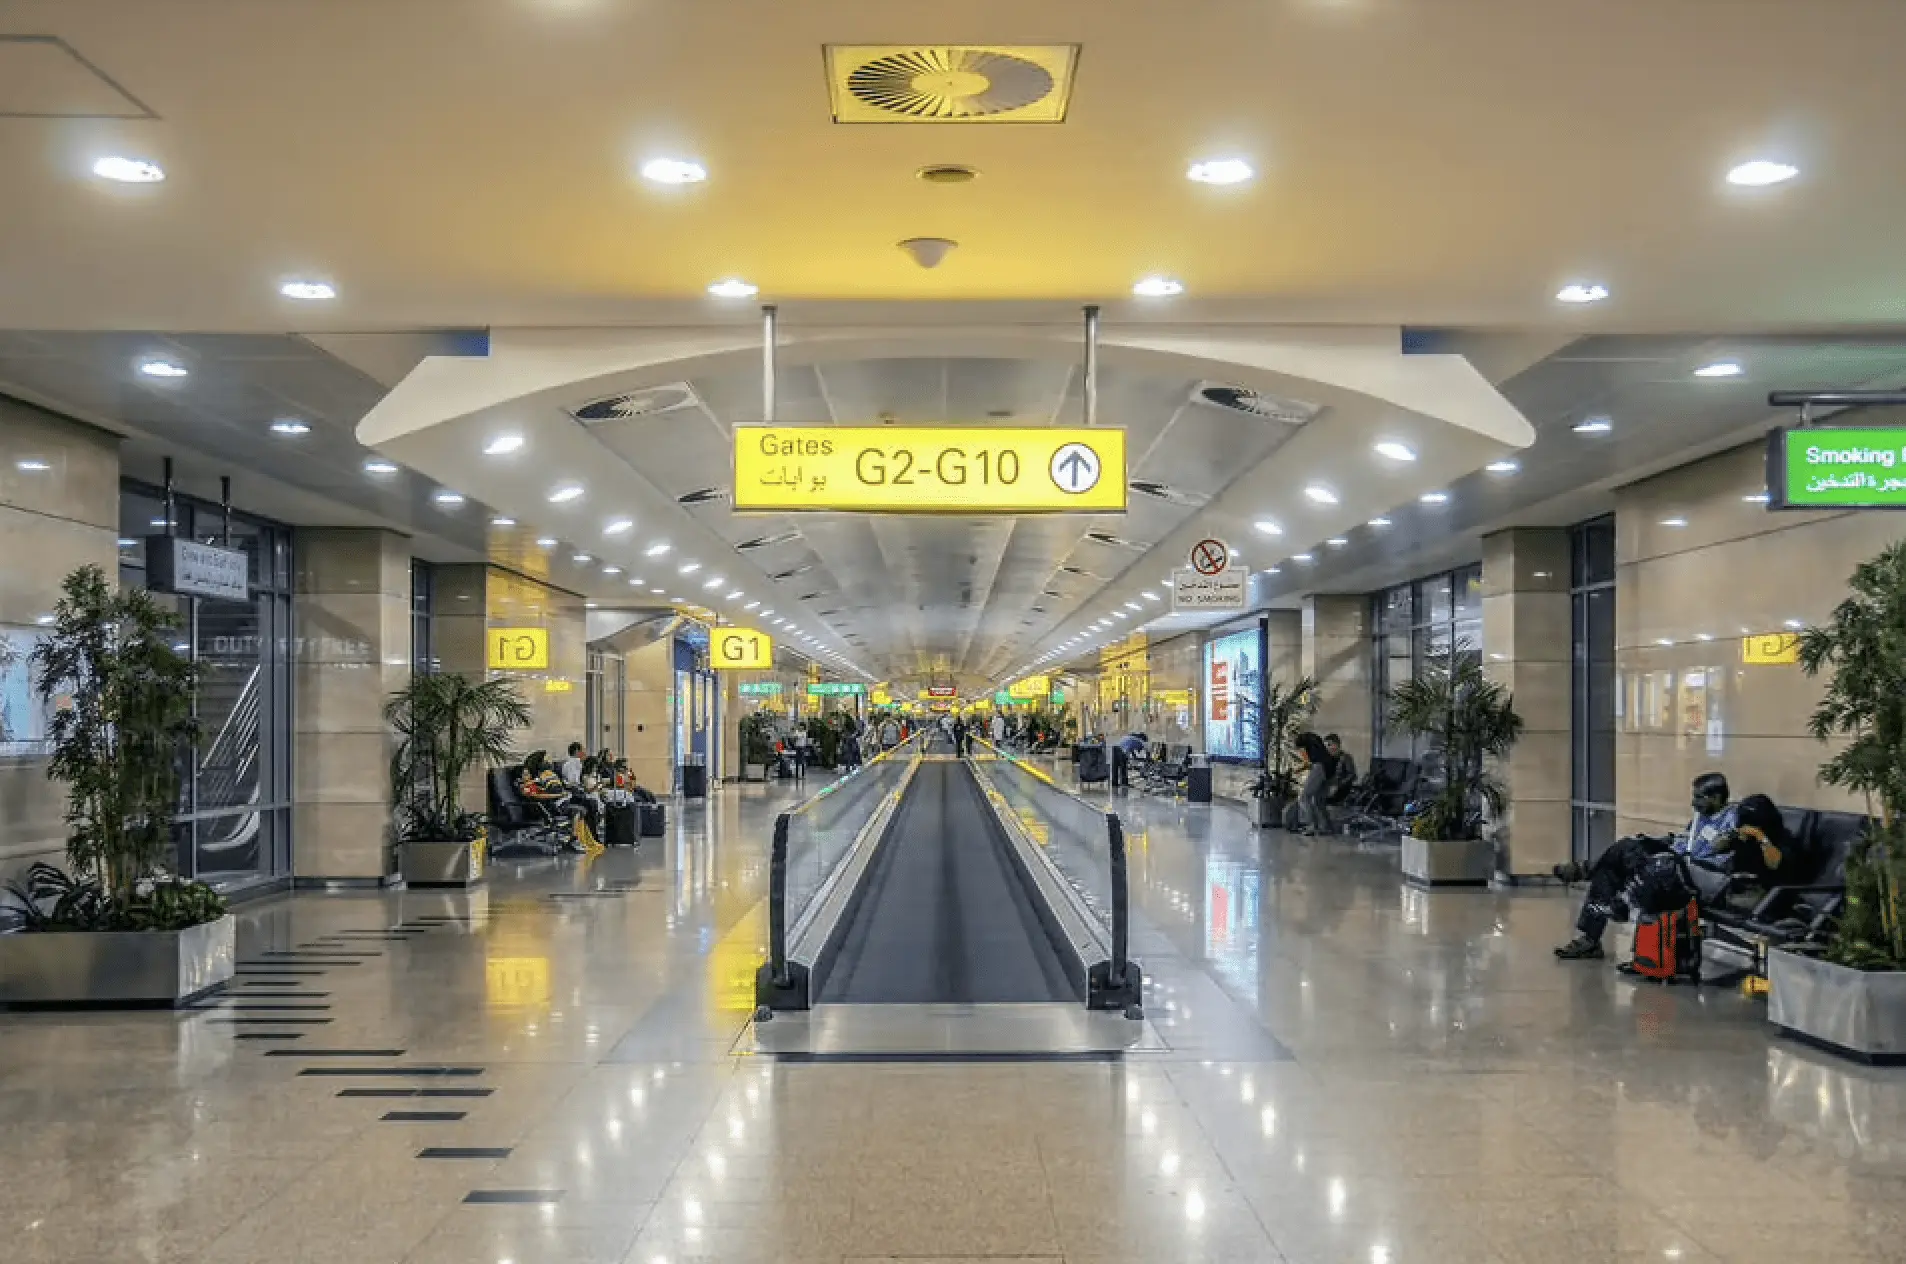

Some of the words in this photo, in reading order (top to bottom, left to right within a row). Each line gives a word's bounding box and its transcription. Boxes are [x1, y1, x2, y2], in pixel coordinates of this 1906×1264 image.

[759, 433, 834, 456] Gates
[855, 447, 1020, 485] G2-G10
[1805, 446, 1895, 467] Smoking
[1178, 594, 1193, 603] NO
[1197, 594, 1241, 603] SMOKING
[722, 635, 759, 661] G1
